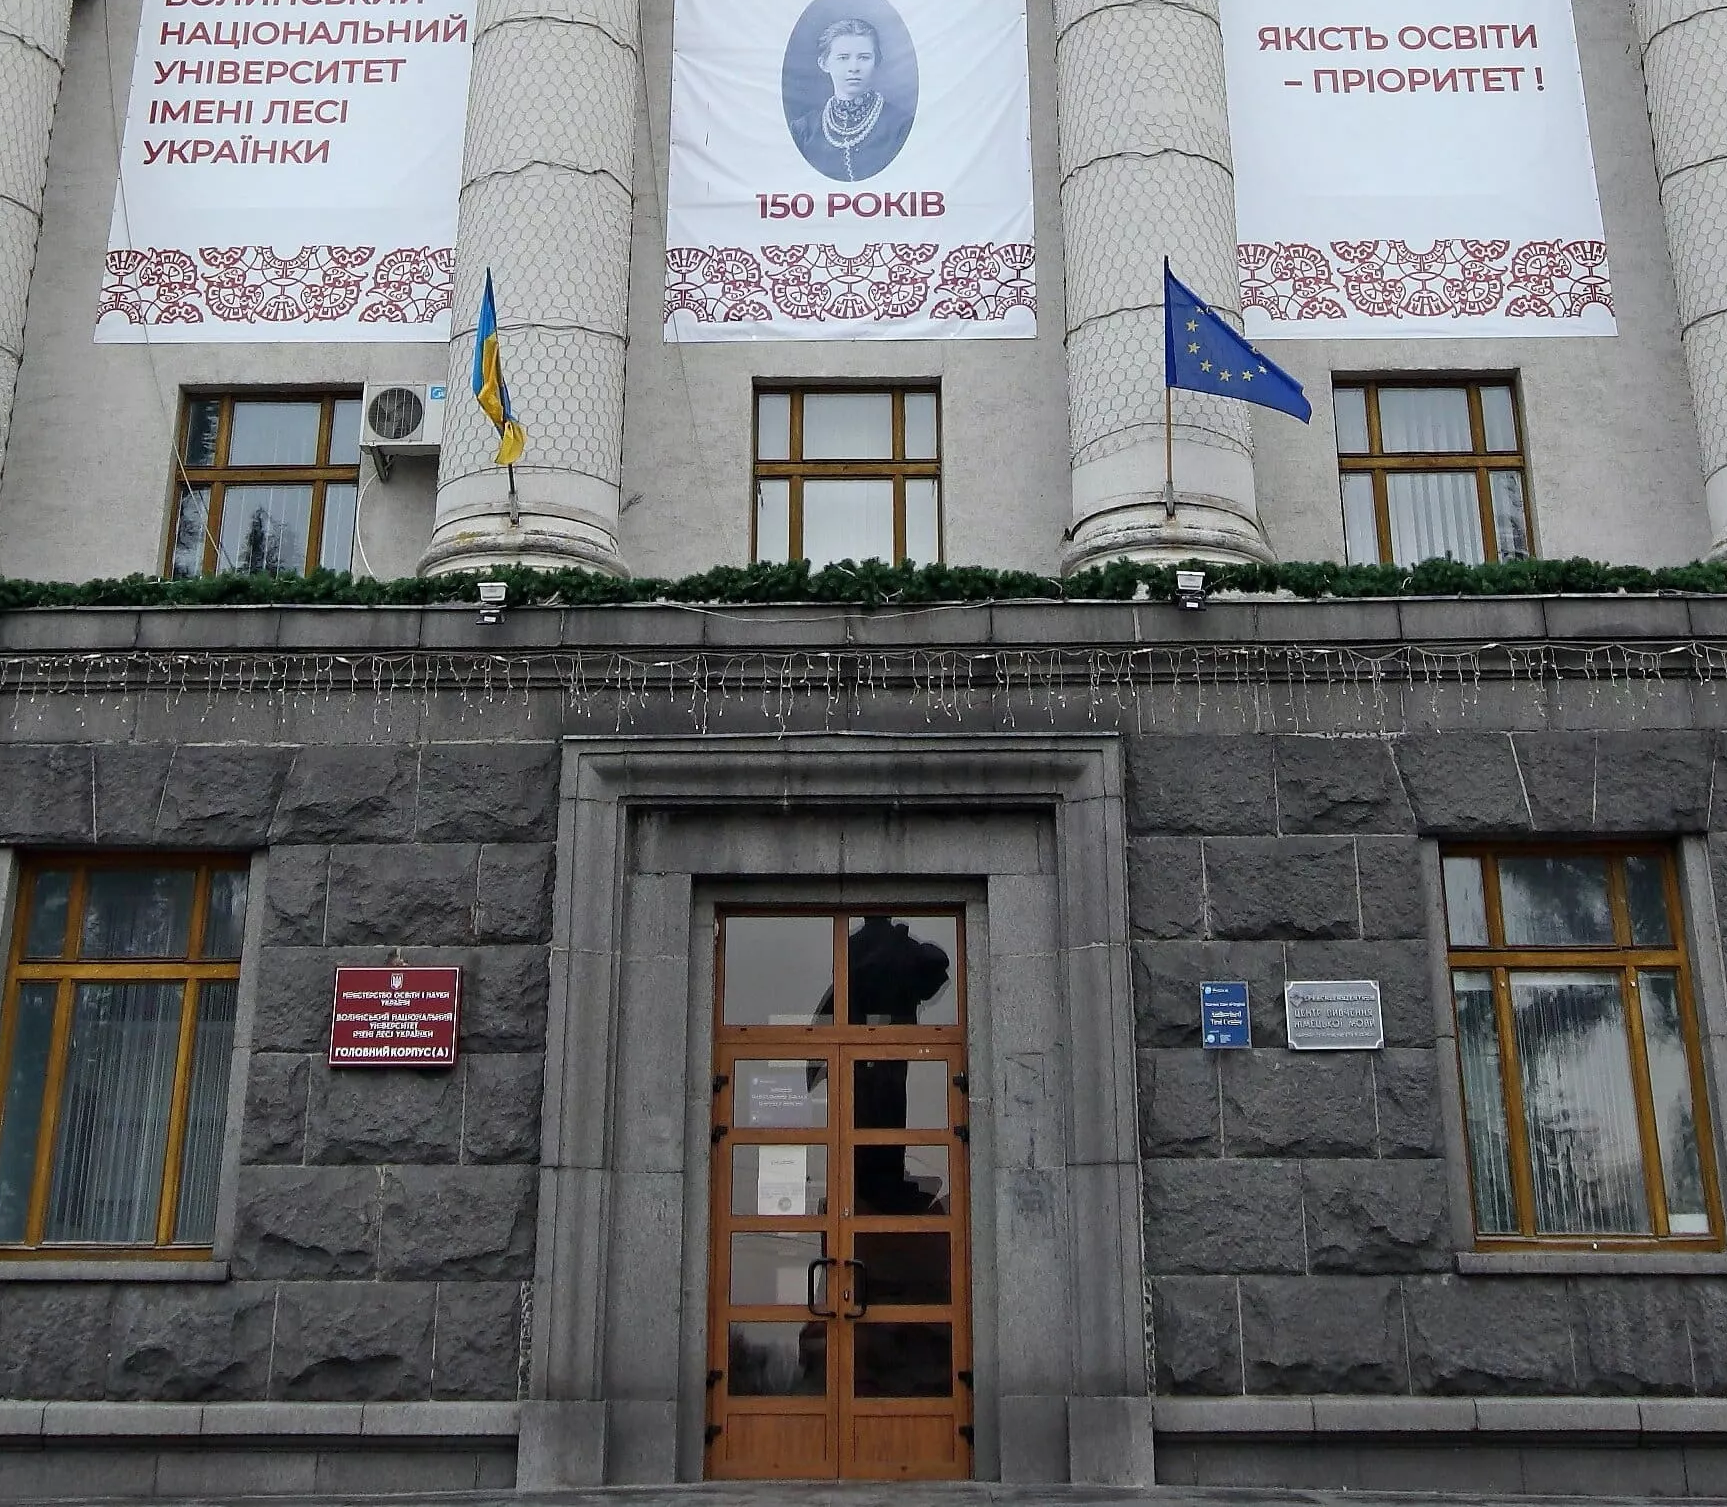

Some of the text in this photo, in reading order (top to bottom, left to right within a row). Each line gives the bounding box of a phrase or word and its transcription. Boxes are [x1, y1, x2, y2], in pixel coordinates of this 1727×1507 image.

[159, 14, 468, 50] НАЦІОНАЛЬНИЙ
[1257, 24, 1538, 51] ЯКІСТЬ ОСВІТИ
[153, 58, 407, 85] УНІВЕРСИТЕТ
[148, 98, 348, 125] ІМЕНІ ЛЕСІ
[142, 134, 331, 165] УКРАЇНКИ
[756, 191, 946, 219] 150 РОКІВ
[335, 1046, 389, 1057] ГОЛОВНИЙ
